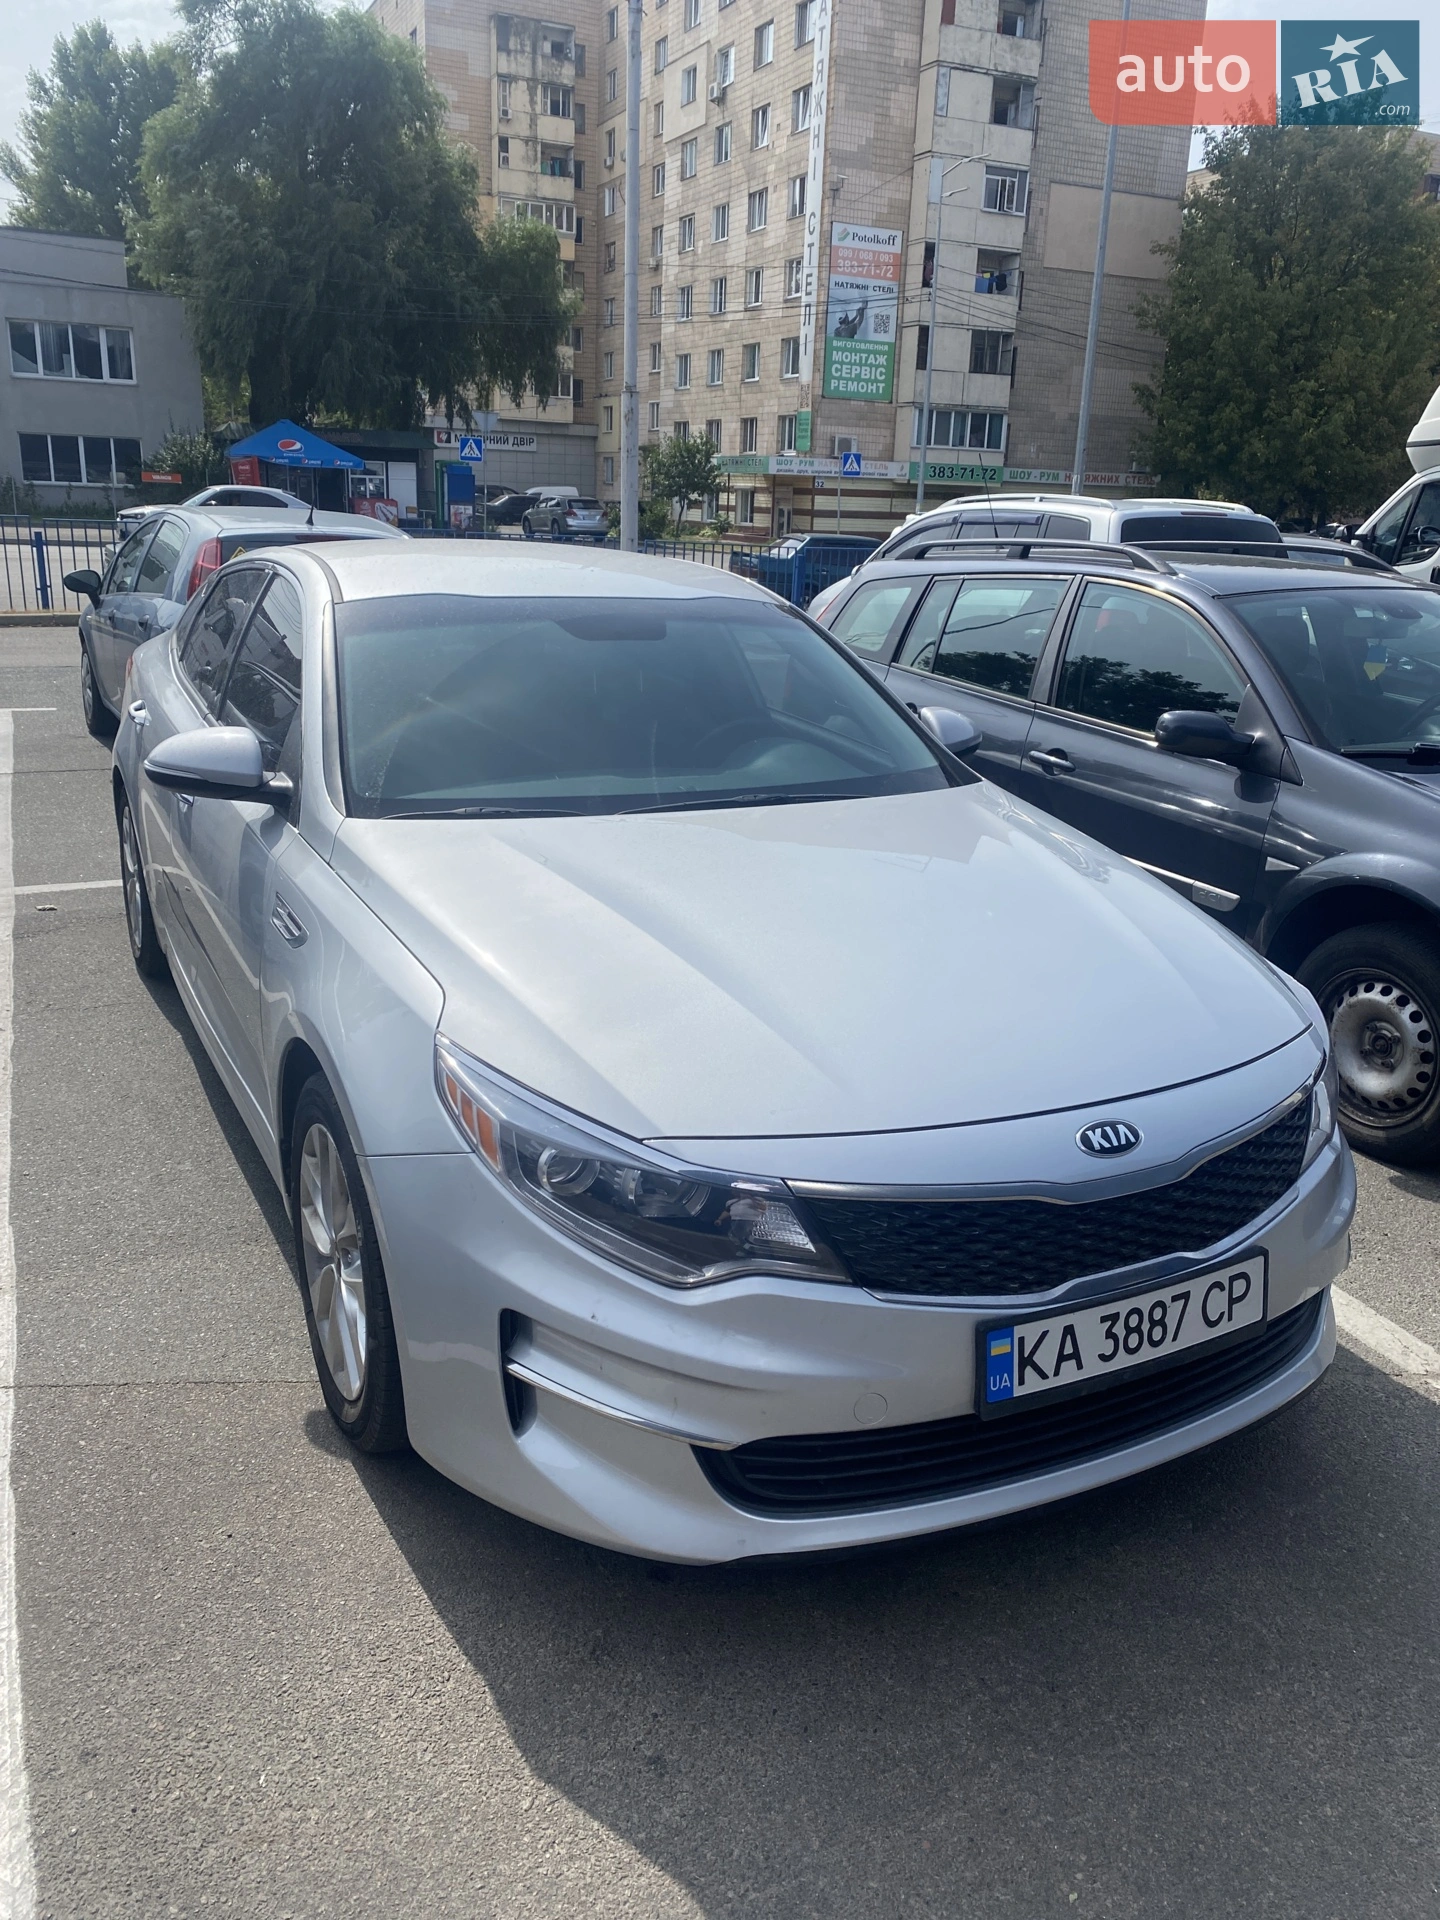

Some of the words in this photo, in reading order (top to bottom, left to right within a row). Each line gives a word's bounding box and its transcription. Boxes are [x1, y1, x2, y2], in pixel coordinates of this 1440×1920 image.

[851, 231, 898, 246] Potolkoff
[838, 248, 853, 258] 099
[859, 250, 873, 260] 068
[879, 253, 894, 263] 093
[837, 260, 894, 278] 383-71-72
[803, 211, 816, 356] СТЕЛІ
[834, 280, 869, 291] НАТЯЖНІ
[872, 285, 894, 294] СТЕЛІ
[832, 340, 889, 351] ВИГОТОВЛЕННЯ
[832, 350, 888, 365] МОНТАЖ
[831, 364, 886, 380] СЕРВІС
[830, 379, 885, 394] РЕМОНТ
[511, 436, 535, 447] ДВІР
[776, 458, 793, 467] ШОУ
[798, 459, 815, 467] РУМ
[864, 462, 889, 470] СТЕЛЬ
[928, 466, 997, 480] 383-71-72
[1009, 469, 1031, 481] ШОУ
[1039, 471, 1060, 482] РУМ
[1064, 472, 1120, 484] НЯЖНИХ
[815, 480, 825, 488] 32
[1085, 1124, 1137, 1151] KIA
[1017, 1323, 1084, 1387] KA
[1097, 1290, 1191, 1363] 3887
[1201, 1271, 1252, 1328] CP
[990, 1372, 1011, 1391] UA
